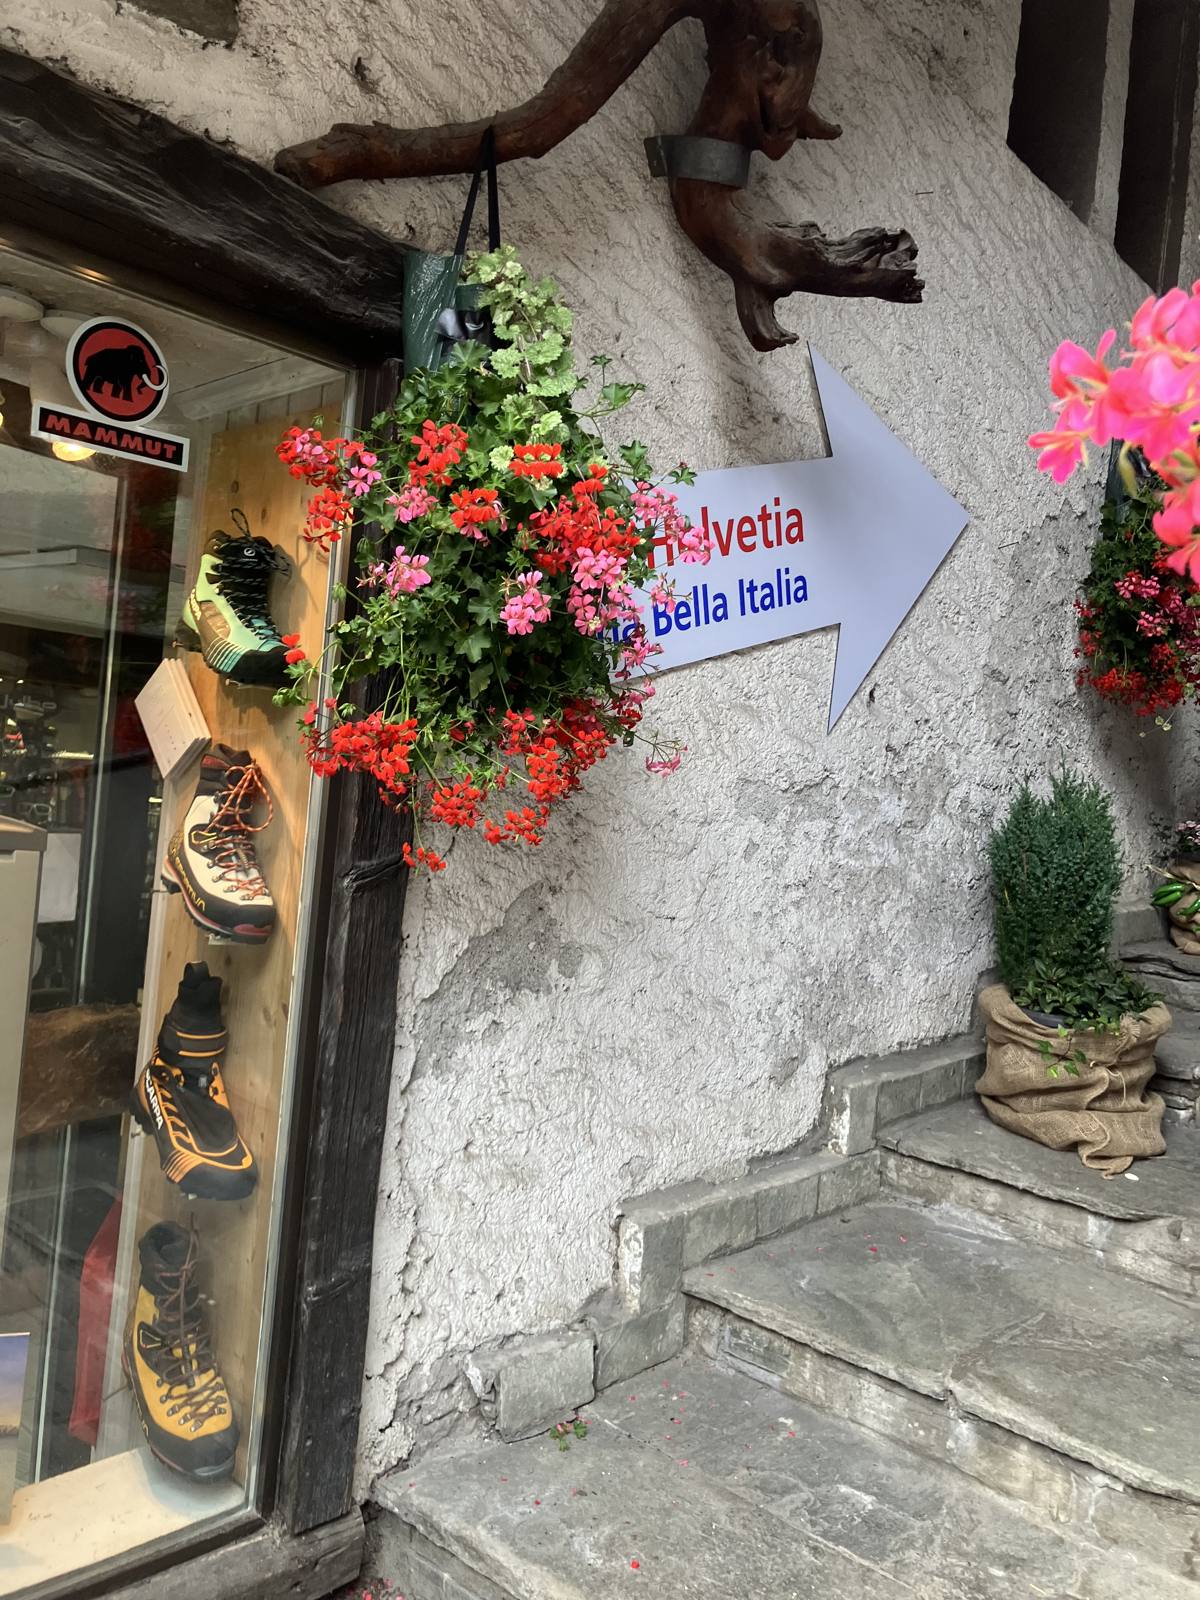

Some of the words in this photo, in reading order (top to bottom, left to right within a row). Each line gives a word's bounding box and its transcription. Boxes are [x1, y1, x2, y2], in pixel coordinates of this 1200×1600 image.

[46, 414, 177, 459] MAMMUT
[653, 583, 729, 637] Bella
[738, 567, 808, 616] Italia
